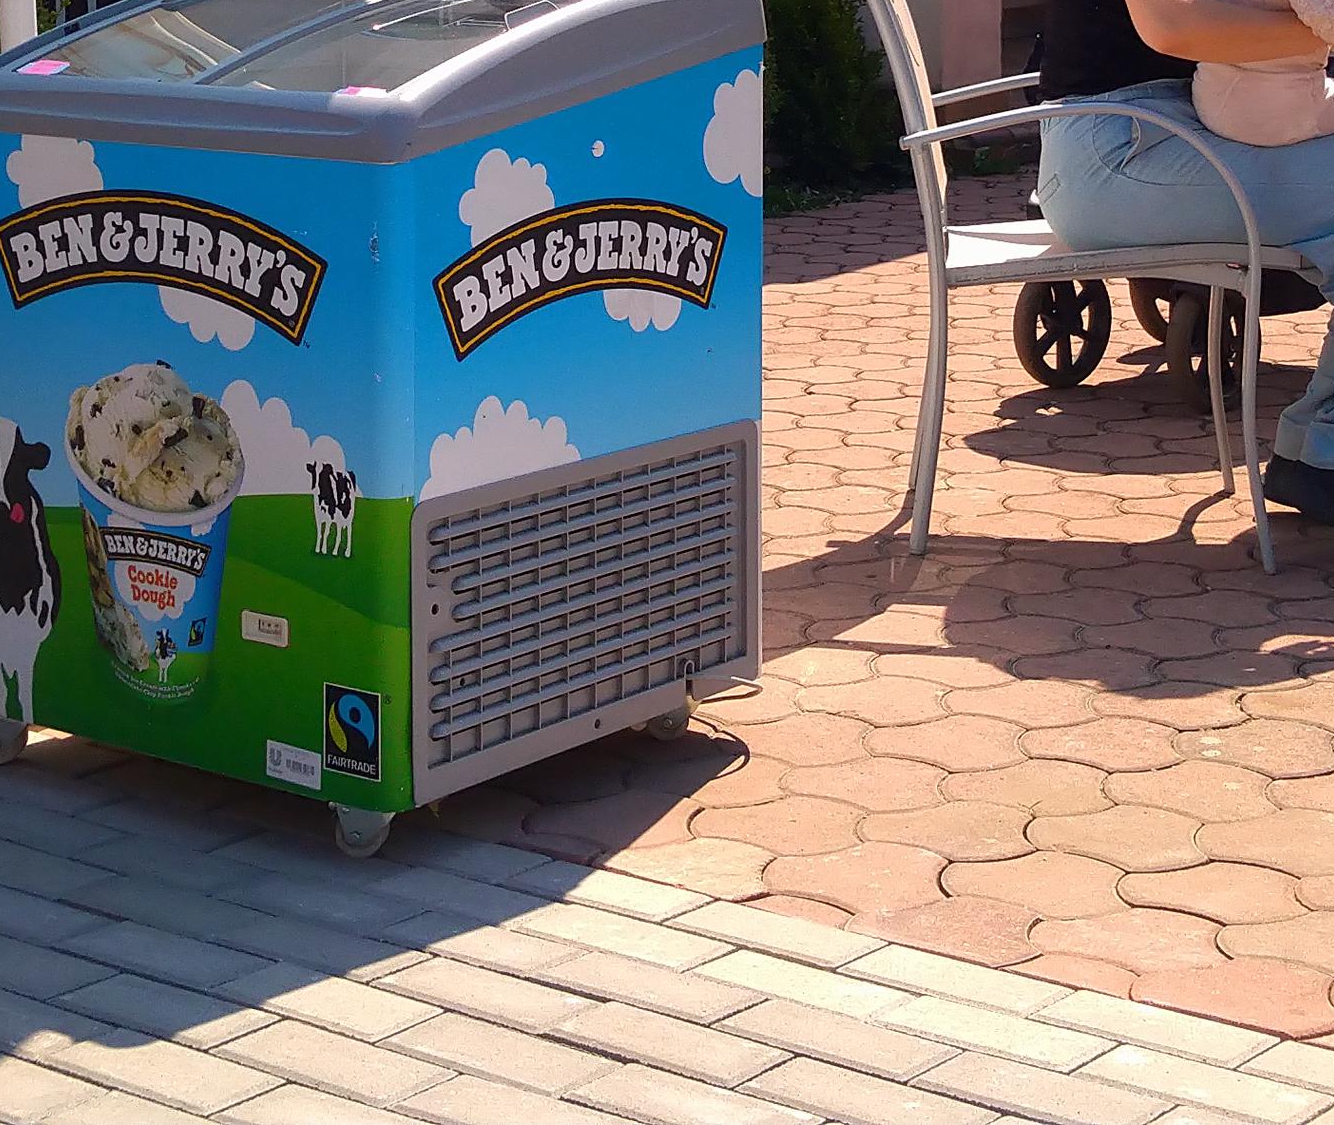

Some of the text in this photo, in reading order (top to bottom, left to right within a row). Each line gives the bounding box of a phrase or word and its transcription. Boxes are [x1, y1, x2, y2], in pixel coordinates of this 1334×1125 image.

[128, 565, 177, 590] Cookie
[131, 584, 175, 610] Dough
[327, 754, 376, 775] FAIRTRADE
